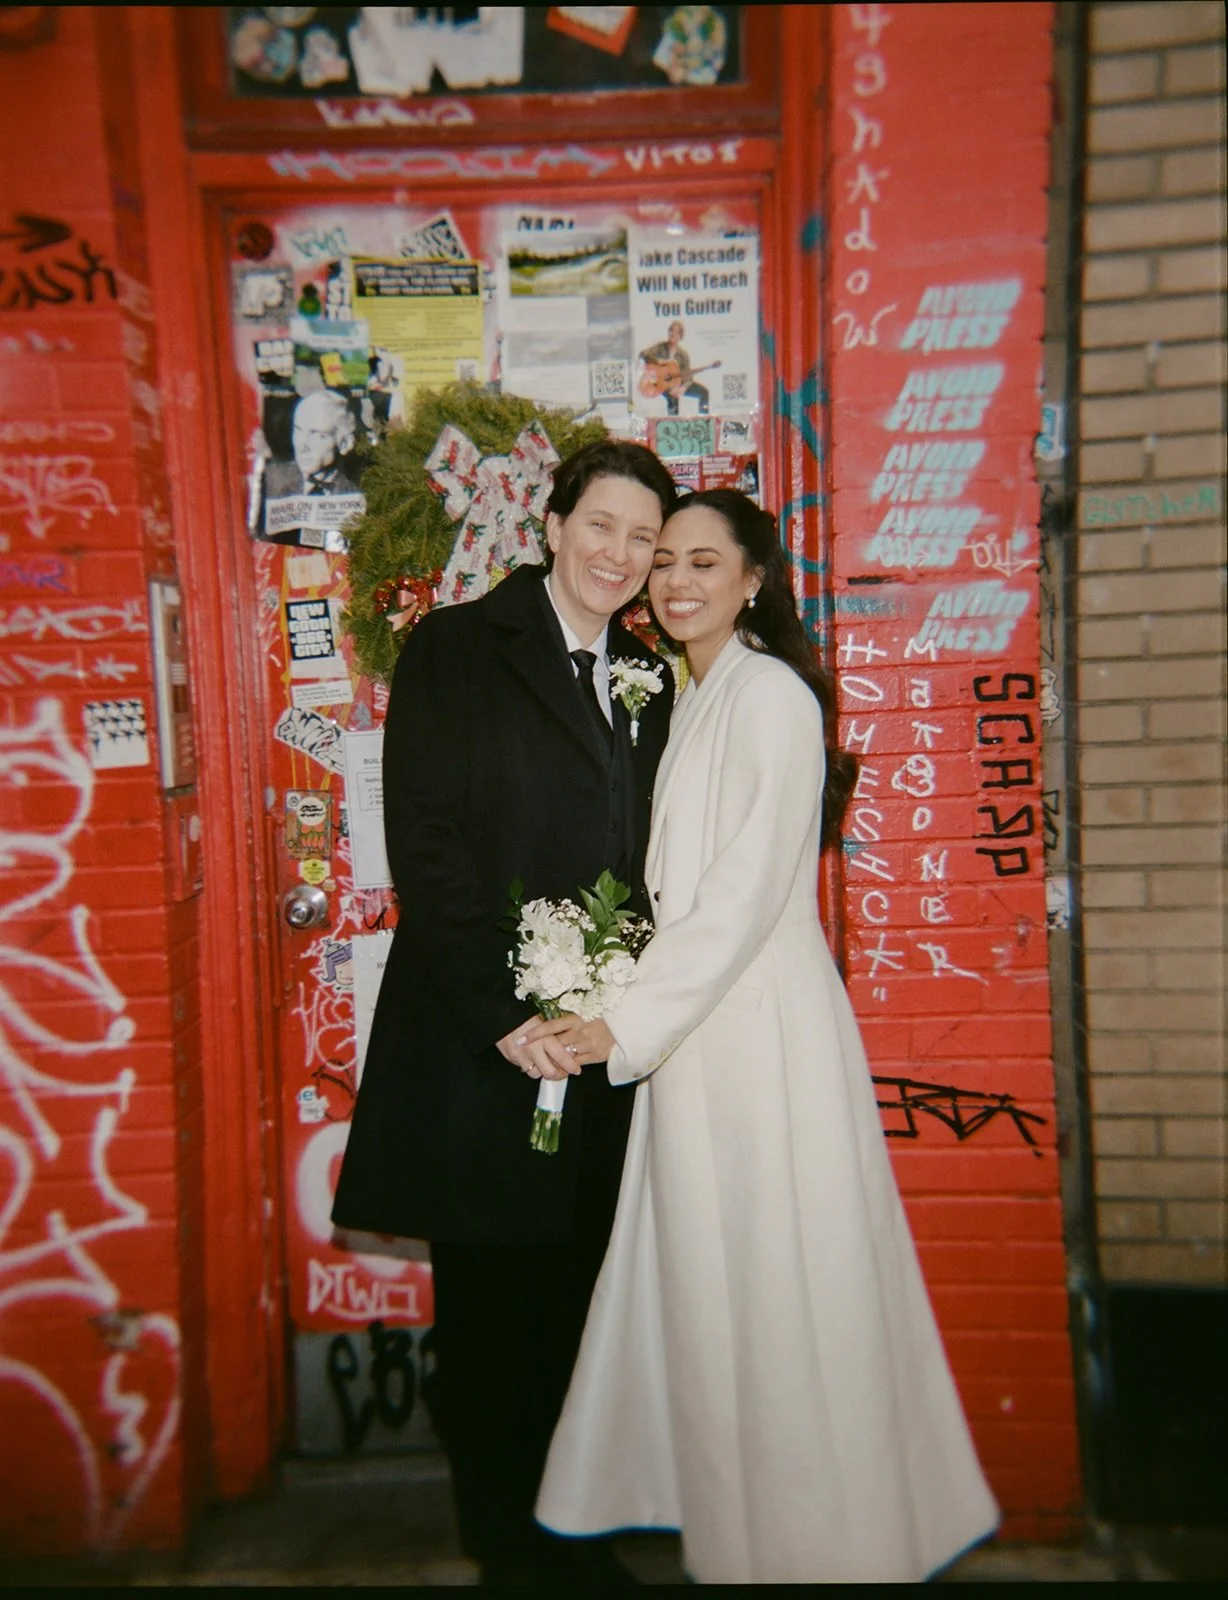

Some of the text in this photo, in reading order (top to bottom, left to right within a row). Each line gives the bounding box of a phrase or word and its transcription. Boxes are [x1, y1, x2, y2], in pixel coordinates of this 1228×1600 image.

[677, 245, 746, 266] Cascade
[637, 272, 748, 293] Will Not Teach
[917, 277, 1022, 317] AVOID
[653, 298, 732, 317] You Guitar
[899, 314, 1010, 354] PRESS
[898, 361, 1005, 399] AVOID
[884, 397, 993, 432] PRESS
[882, 440, 985, 471] AVOID
[869, 470, 969, 503] PRESS
